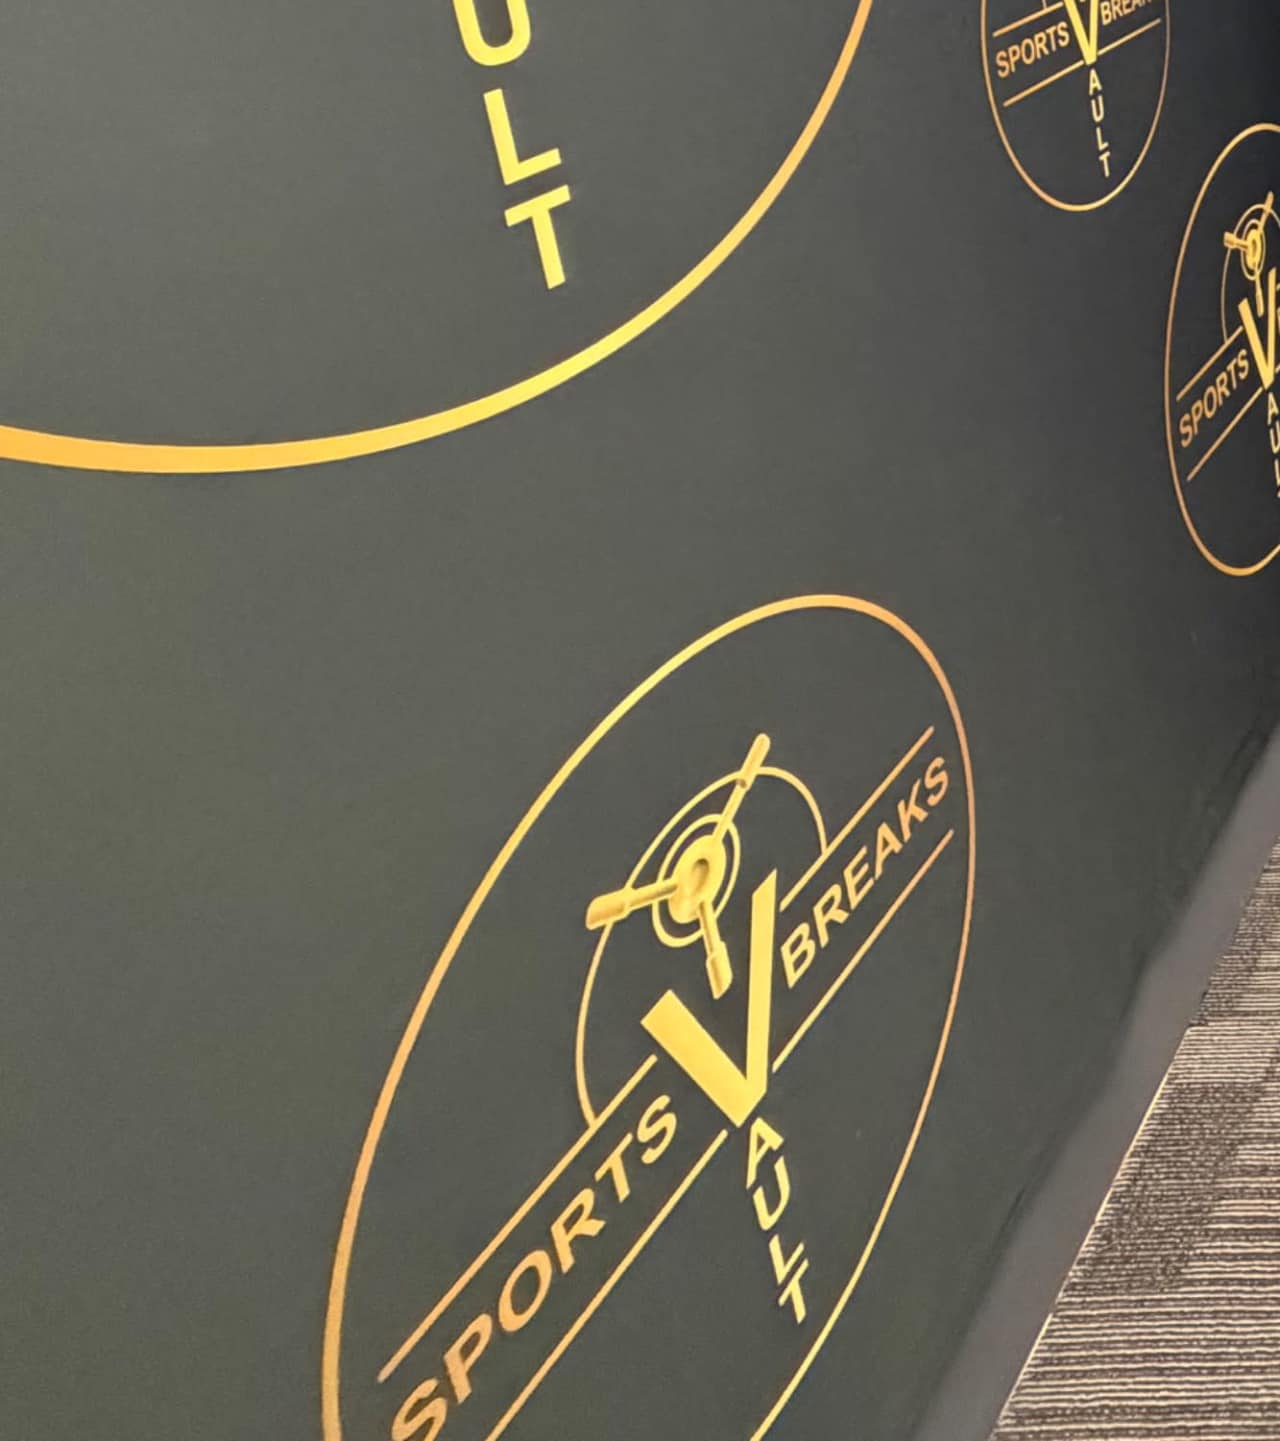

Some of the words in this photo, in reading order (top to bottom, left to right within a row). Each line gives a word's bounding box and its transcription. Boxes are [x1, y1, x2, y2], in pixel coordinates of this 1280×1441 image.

[995, 21, 1071, 79] SPORTS
[1178, 348, 1250, 449] SPORTS
[390, 1094, 679, 1441] SPORTS
[778, 756, 951, 989] BREAKS
